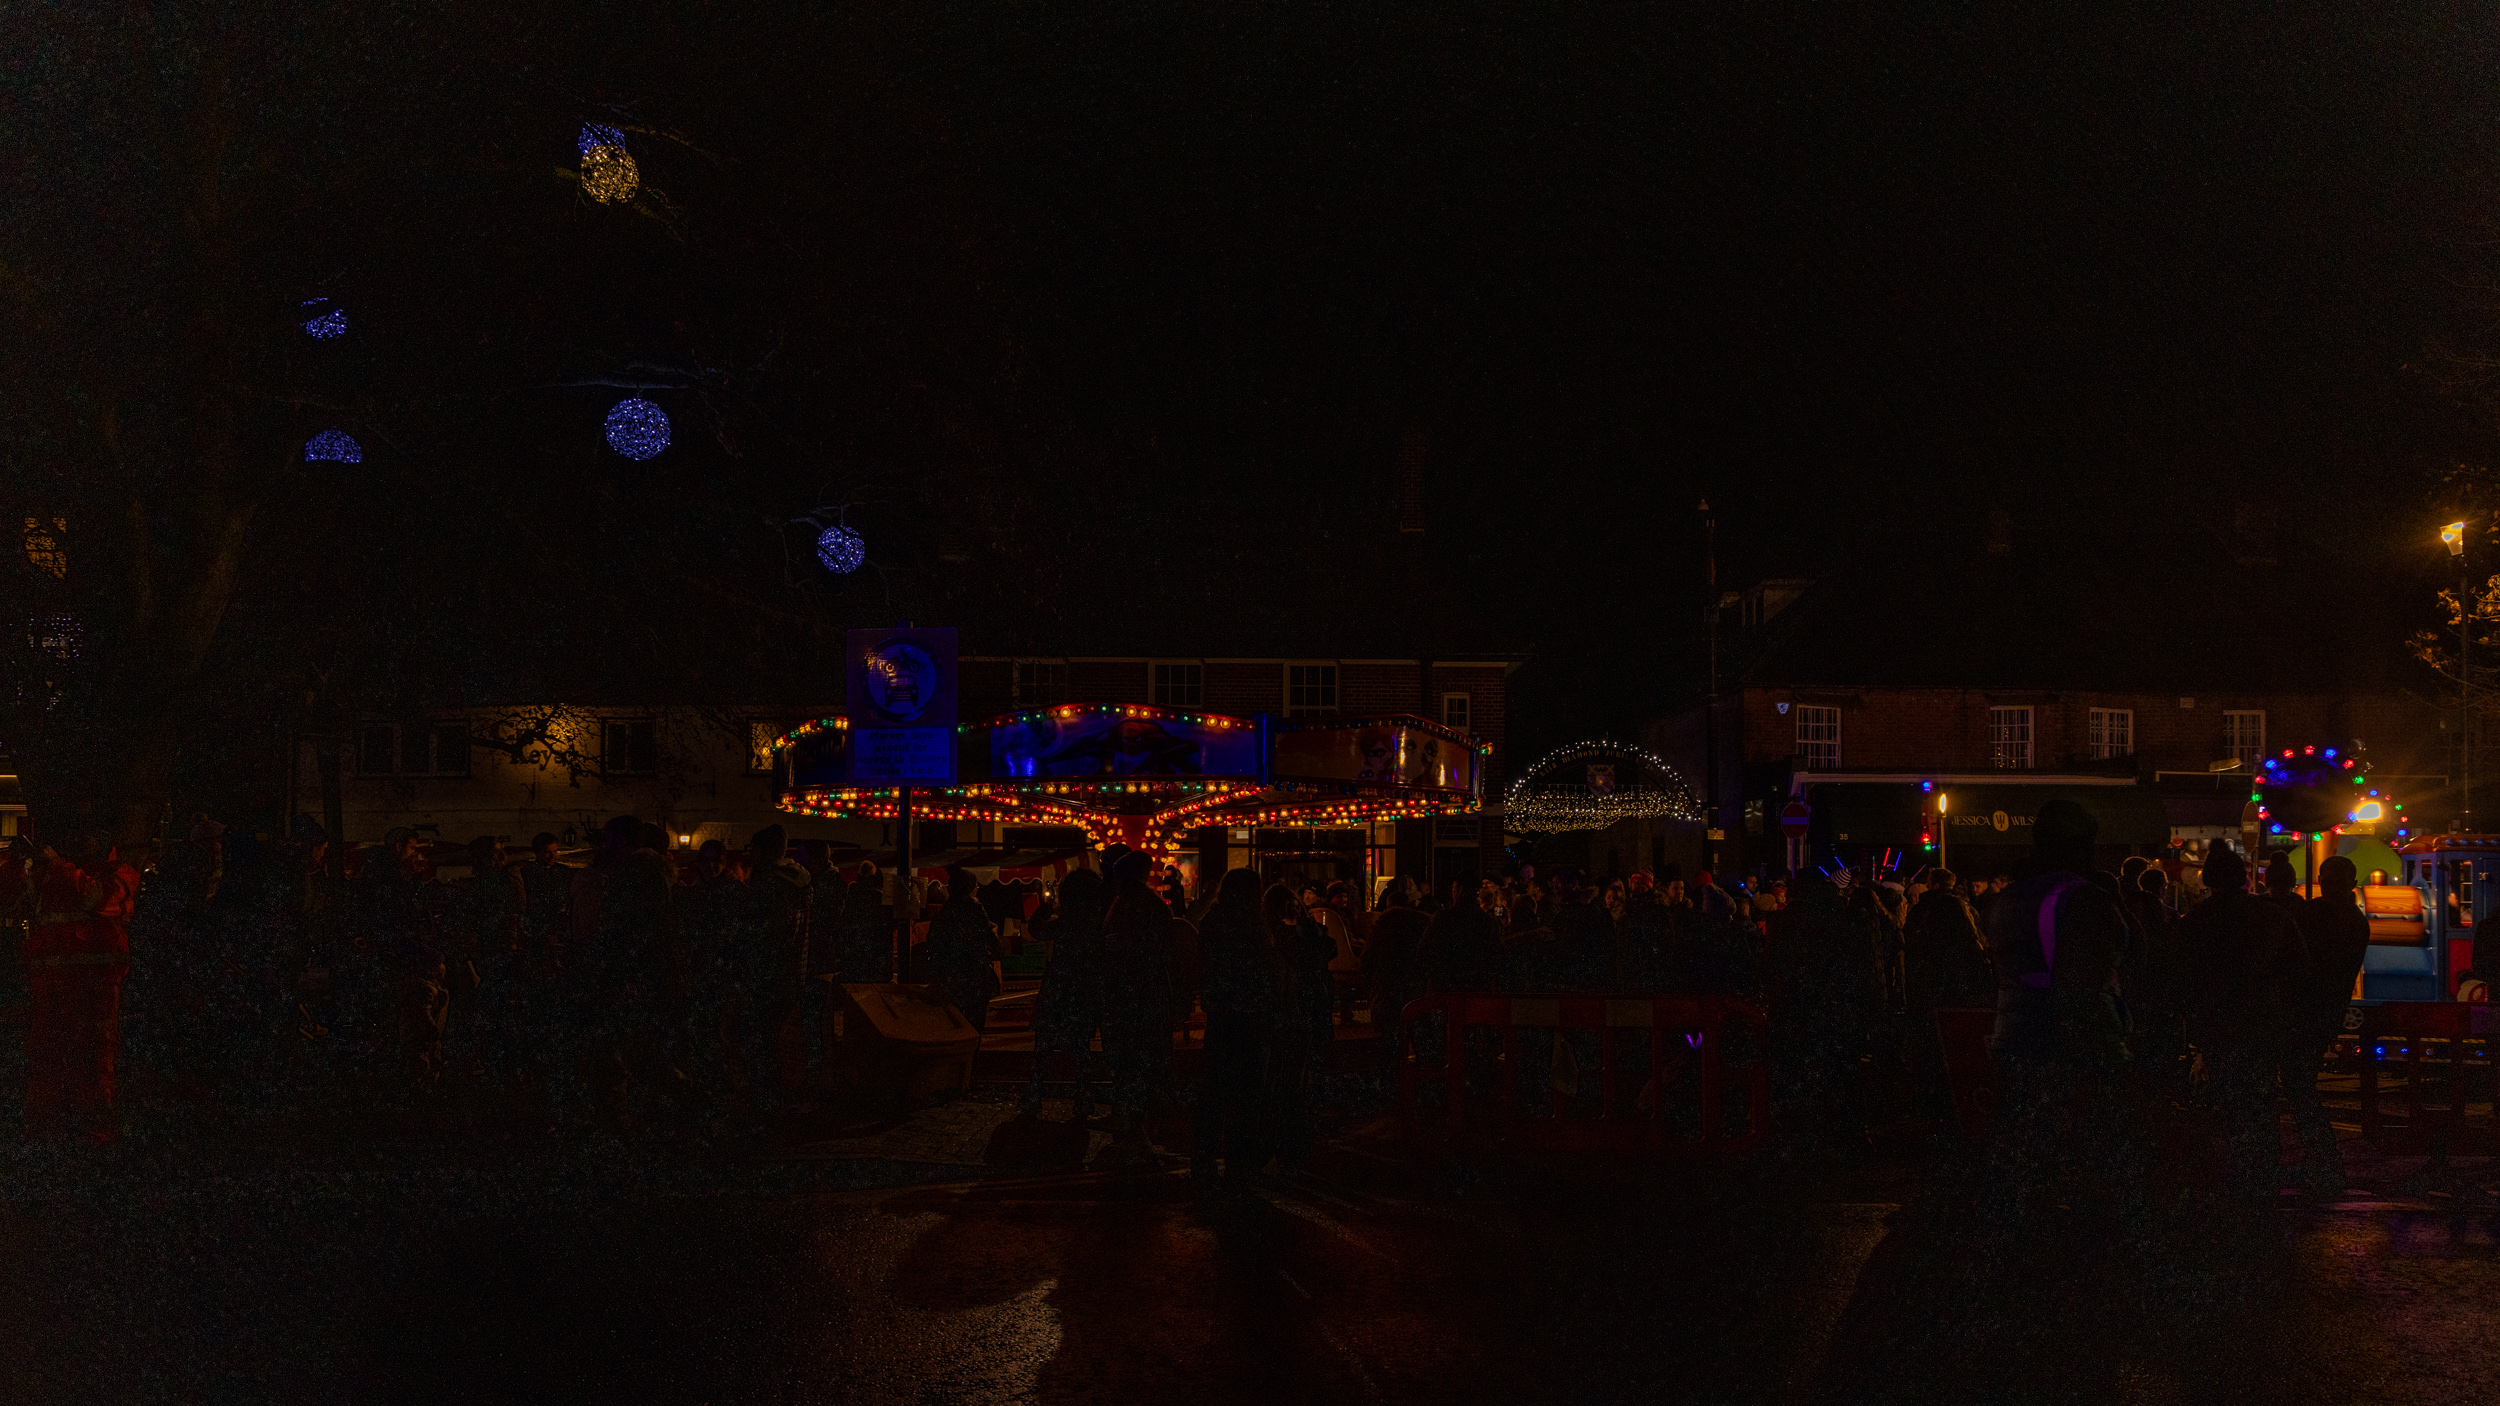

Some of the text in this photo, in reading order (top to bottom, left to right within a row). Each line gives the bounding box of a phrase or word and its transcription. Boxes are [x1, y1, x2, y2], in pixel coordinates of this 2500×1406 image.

[870, 731, 934, 741] Market days
[875, 742, 928, 753] except for
[856, 756, 891, 764] access
[894, 755, 905, 764] to
[1561, 750, 1600, 764] DIAMOND
[1951, 815, 2038, 826] JESSICA WILS
[1839, 833, 1849, 841] 35
